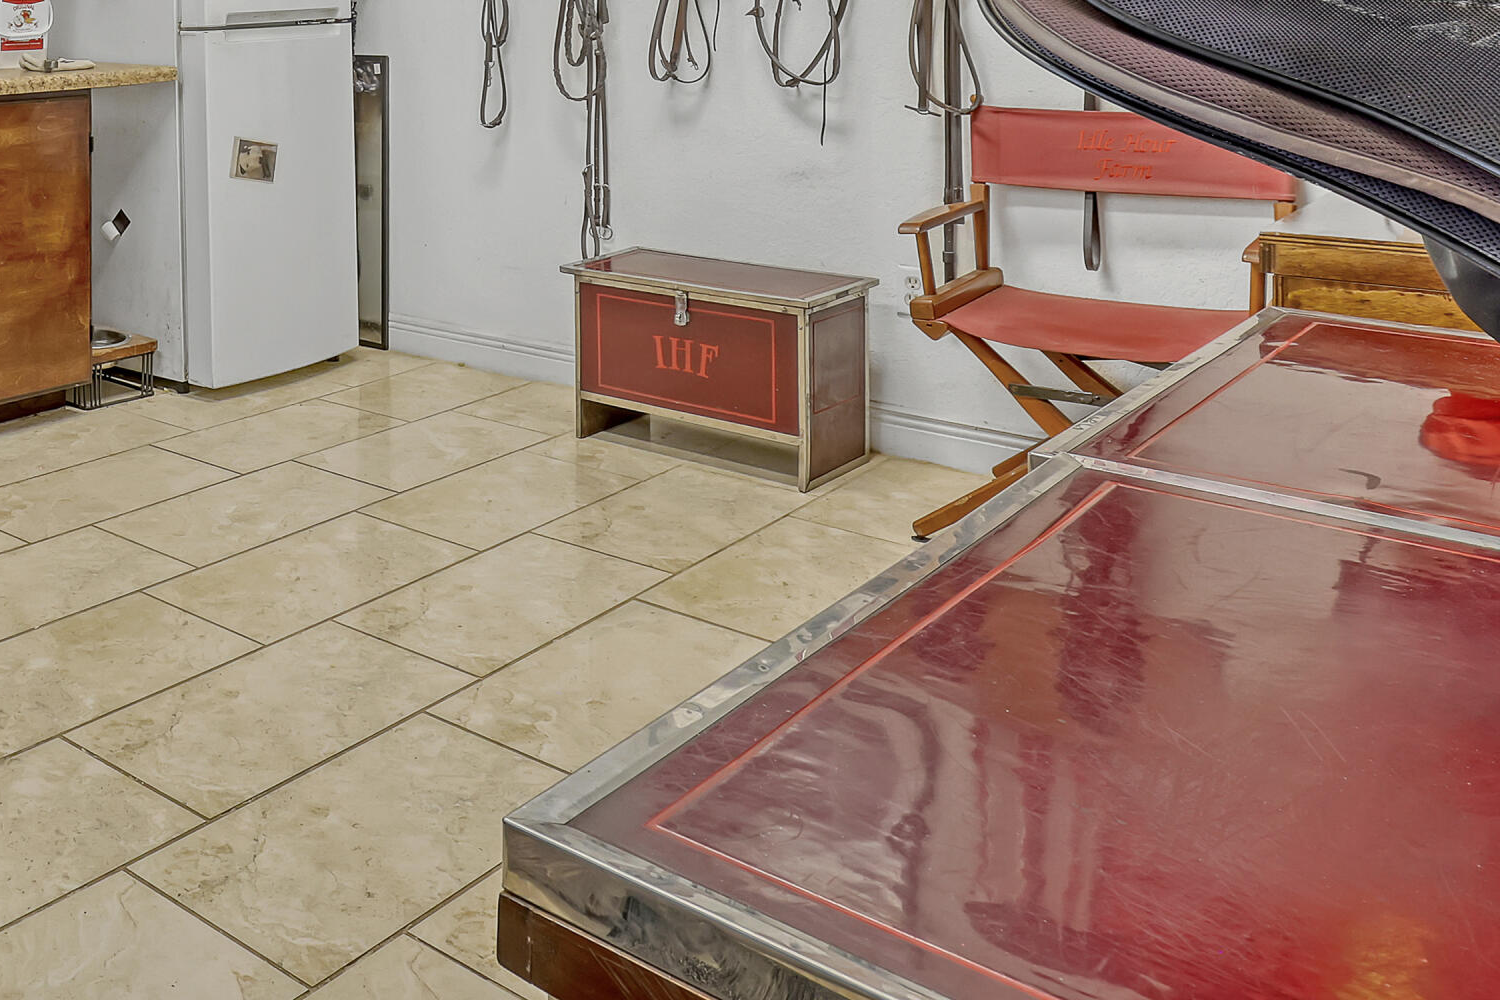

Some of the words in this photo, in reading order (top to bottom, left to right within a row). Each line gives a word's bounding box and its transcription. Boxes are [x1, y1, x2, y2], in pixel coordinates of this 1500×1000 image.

[1077, 129, 1115, 151] Idle
[1120, 132, 1178, 154] Hour
[1093, 158, 1153, 180] Farm
